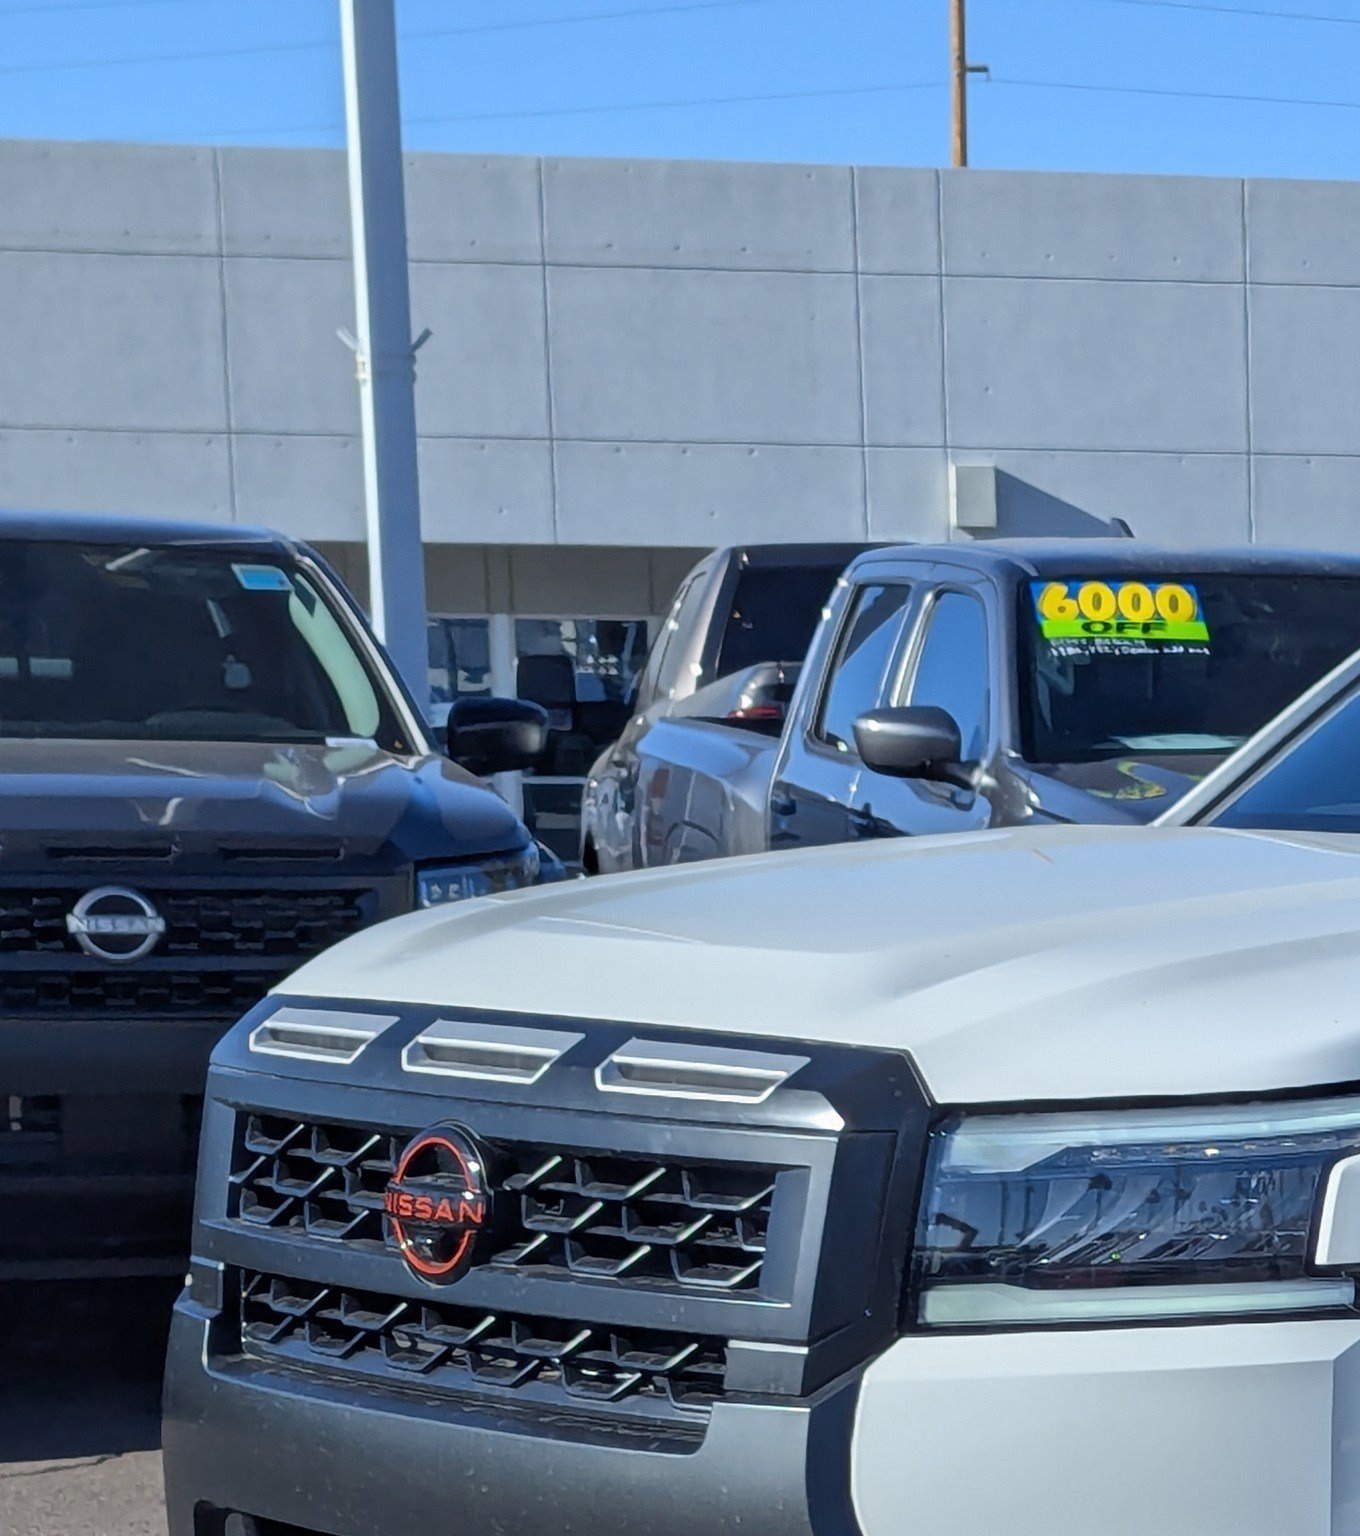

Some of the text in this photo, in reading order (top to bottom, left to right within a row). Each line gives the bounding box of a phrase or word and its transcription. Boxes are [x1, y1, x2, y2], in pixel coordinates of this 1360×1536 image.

[1038, 581, 1198, 621] 6000
[1081, 620, 1167, 634] OFF
[386, 1192, 483, 1224] NISSAN
